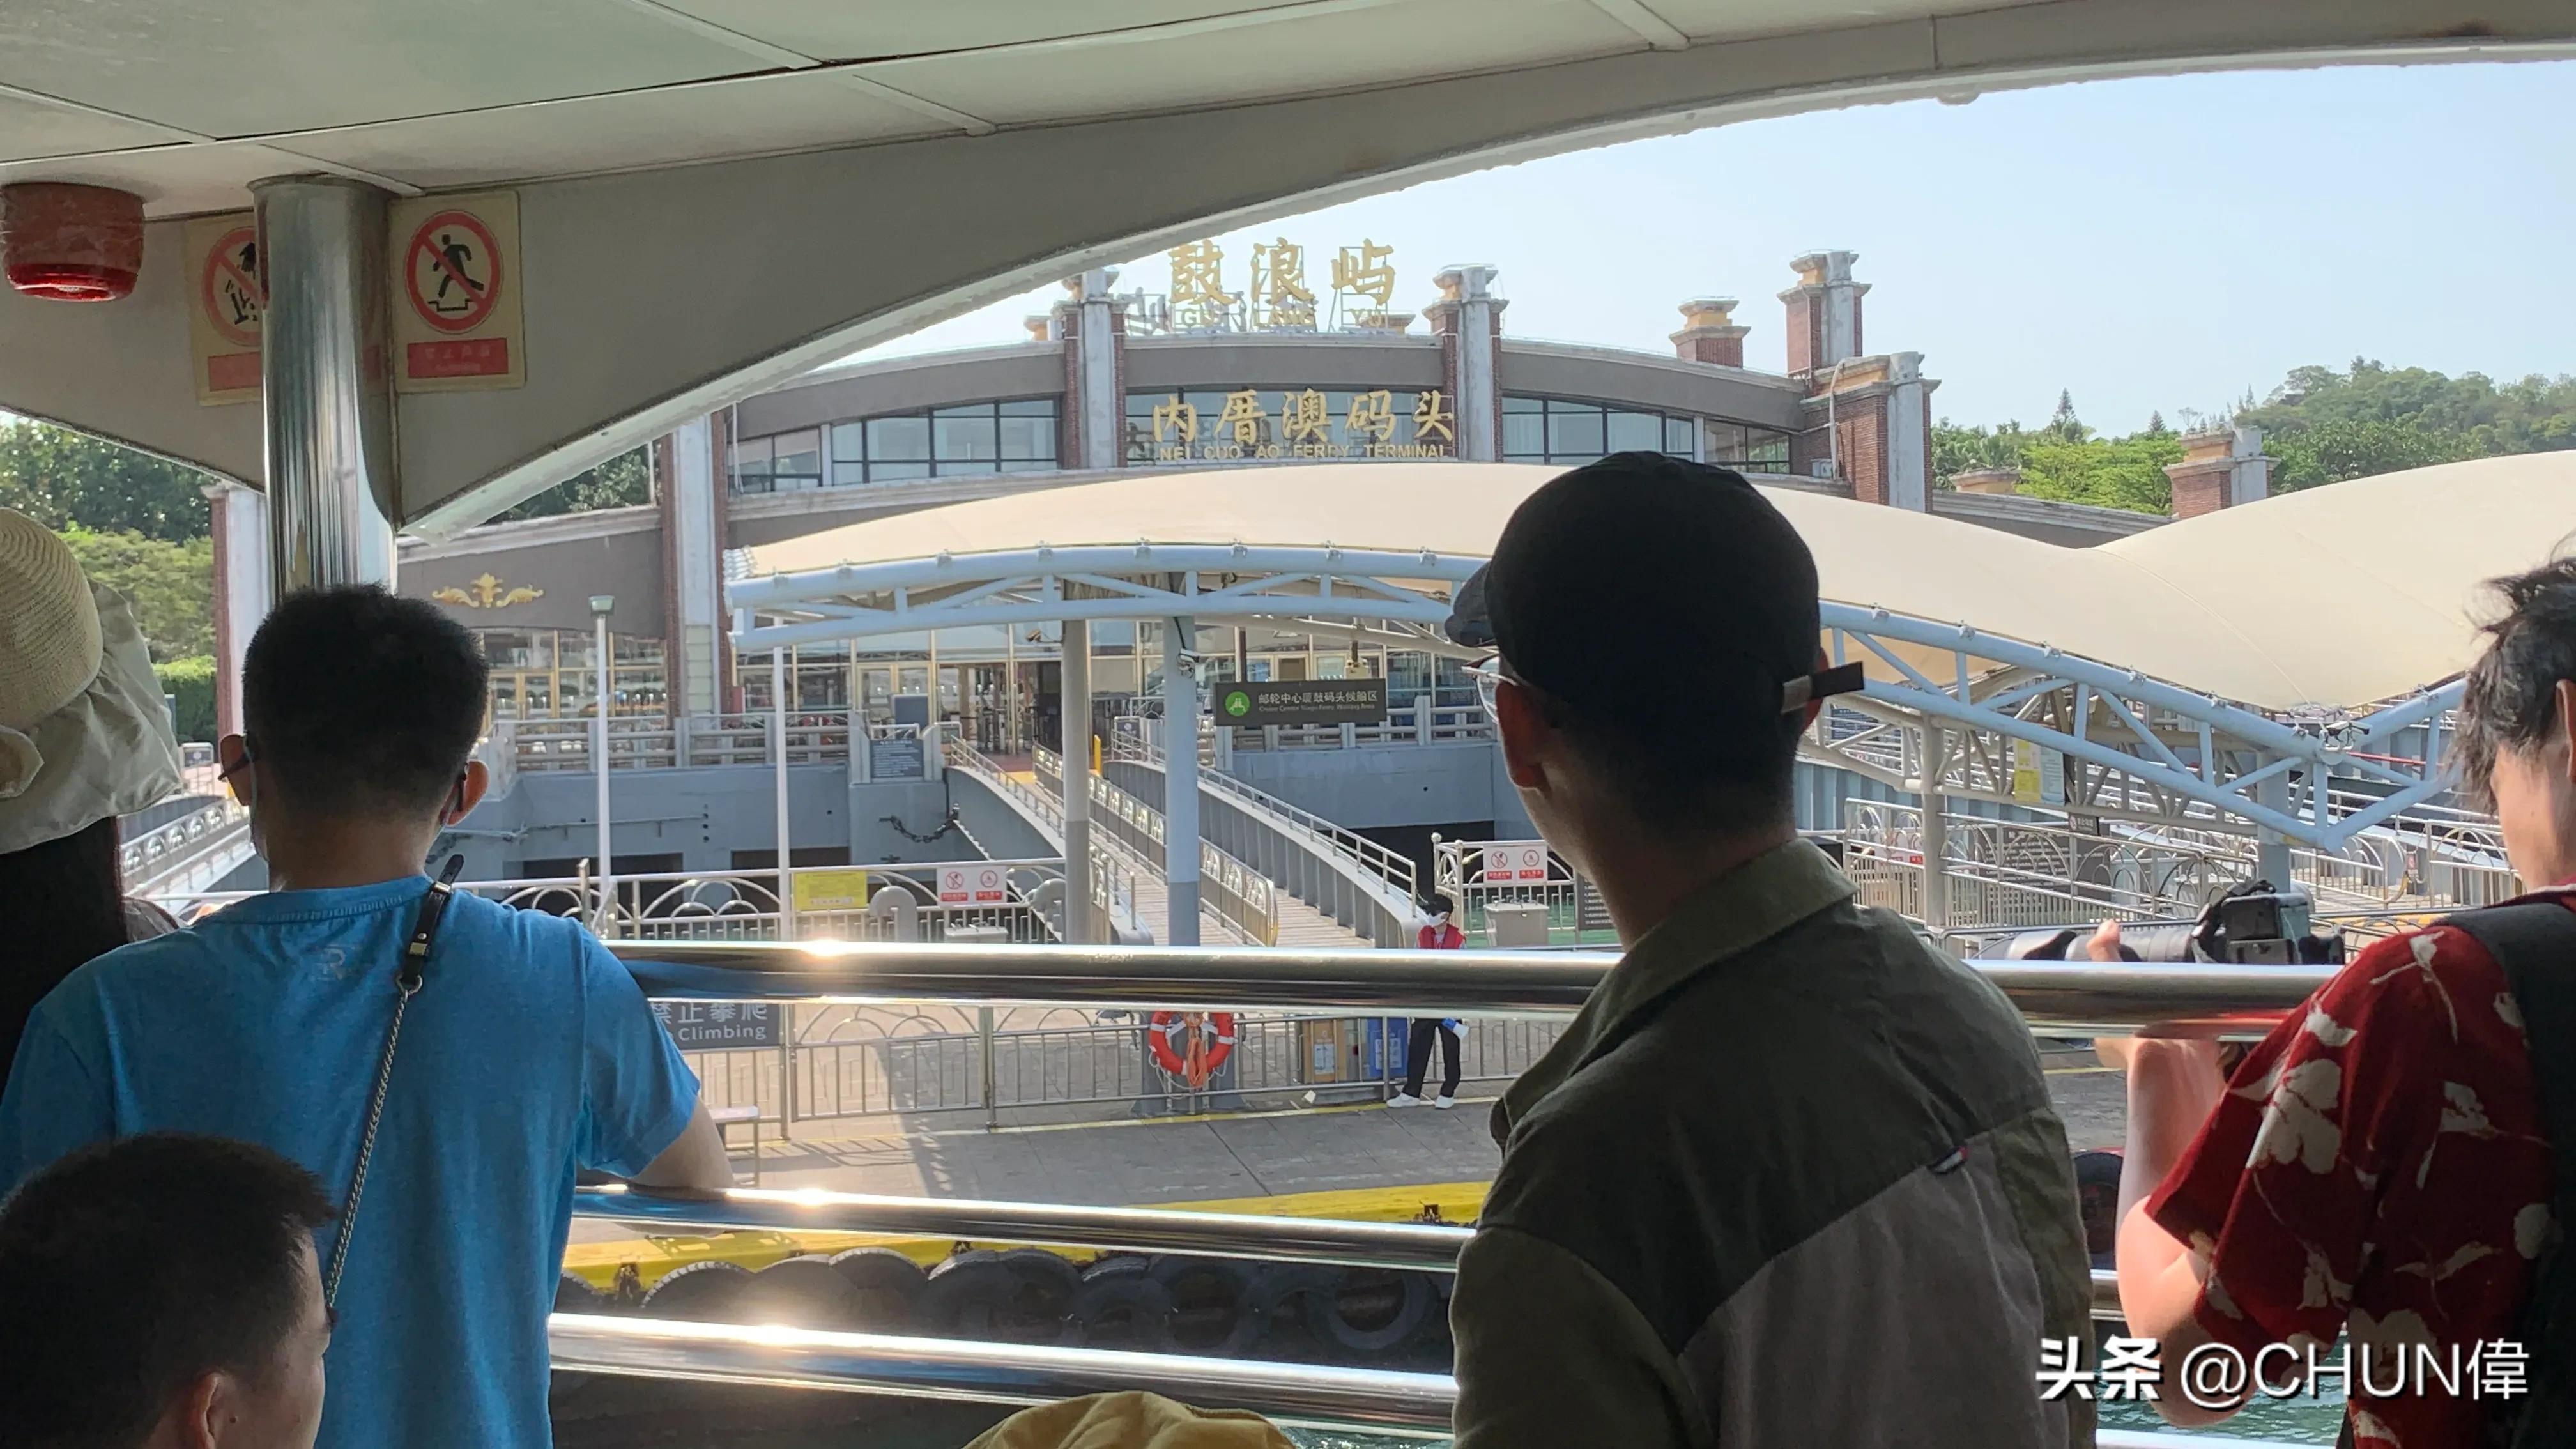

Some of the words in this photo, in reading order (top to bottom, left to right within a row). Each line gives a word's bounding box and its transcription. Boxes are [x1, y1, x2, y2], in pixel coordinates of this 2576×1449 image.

[1168, 237, 1396, 307] 鼓浪屿
[1153, 388, 1455, 445] 内厝澳码头
[1160, 447, 1190, 461] NEI
[1255, 445, 1280, 459] AO
[1293, 445, 1349, 458] FERRY
[1363, 444, 1446, 457] TERMINAL
[1258, 690, 1378, 704] 邮轮中心厦鼓码头候船区
[678, 1024, 766, 1041] Climbing
